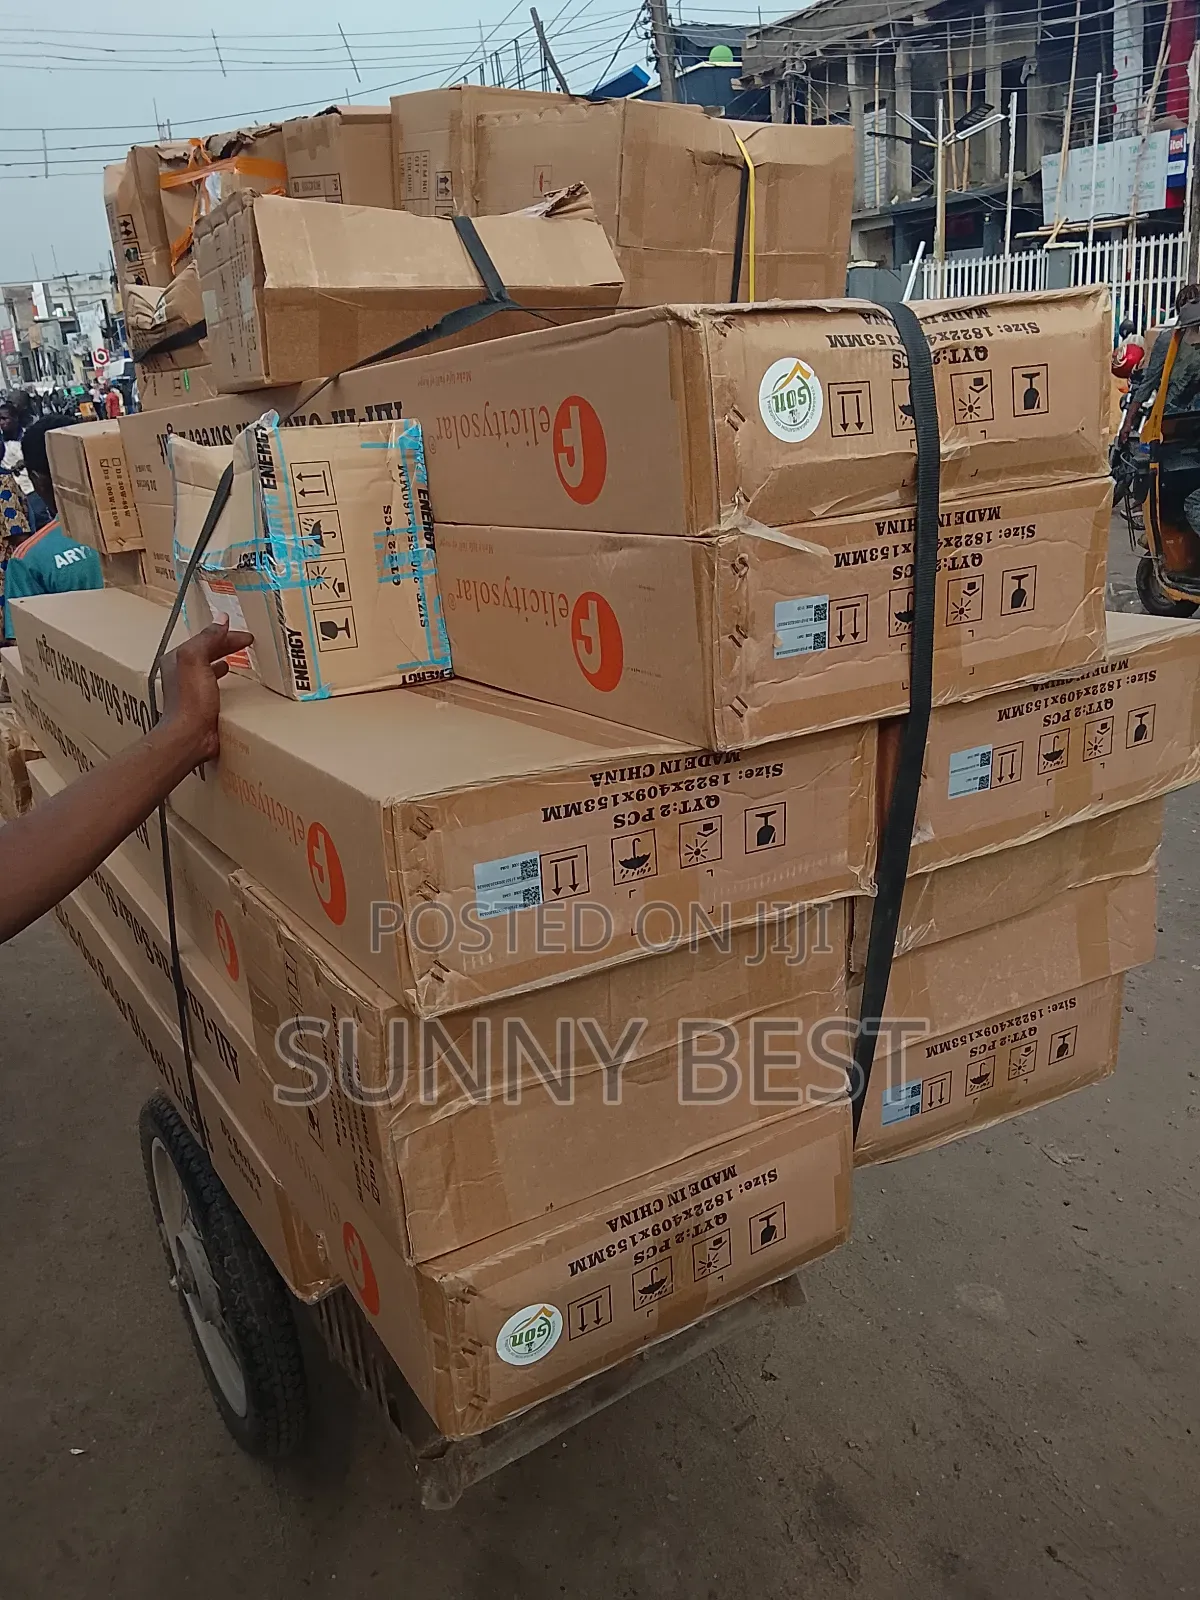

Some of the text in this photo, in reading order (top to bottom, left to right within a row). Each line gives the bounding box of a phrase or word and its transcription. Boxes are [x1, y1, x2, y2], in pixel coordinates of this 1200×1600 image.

[1170, 138, 1184, 151] itel
[997, 322, 1040, 335] Size:
[954, 506, 1001, 525] MADE
[998, 524, 1036, 539] Size:
[54, 545, 91, 569] ARY
[286, 627, 311, 691] ENERGY
[1126, 670, 1157, 684] Size:
[1042, 709, 1071, 728] PCS
[590, 750, 741, 788] MADE IN CHINA
[541, 762, 784, 824] Size: 1822x409x153MM
[612, 793, 721, 829] QYT:2 PCS
[1047, 996, 1077, 1013] Size:
[969, 1039, 997, 1058] PCS
[739, 1167, 779, 1194] Size:
[606, 1164, 738, 1233] MADE IN CHINA
[633, 1212, 729, 1266] QYT:2 PCS
